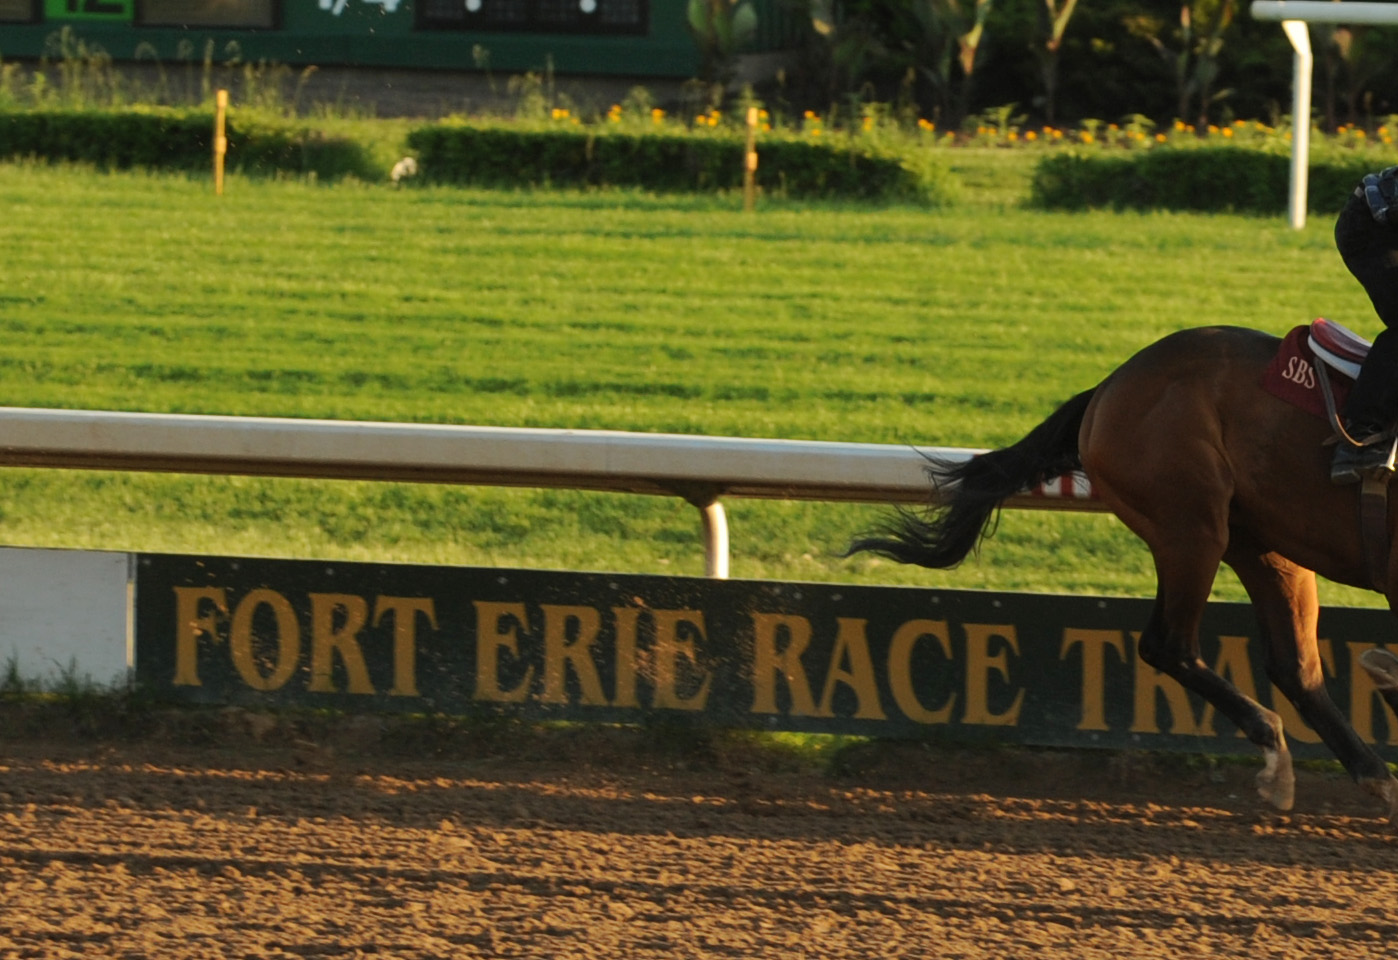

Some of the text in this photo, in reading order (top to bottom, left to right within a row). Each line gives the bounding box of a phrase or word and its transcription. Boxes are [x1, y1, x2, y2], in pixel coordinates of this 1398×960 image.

[1282, 356, 1316, 389] SBS
[172, 585, 439, 698] FORT
[474, 596, 711, 711] ERIE
[749, 611, 1025, 727] RACE
